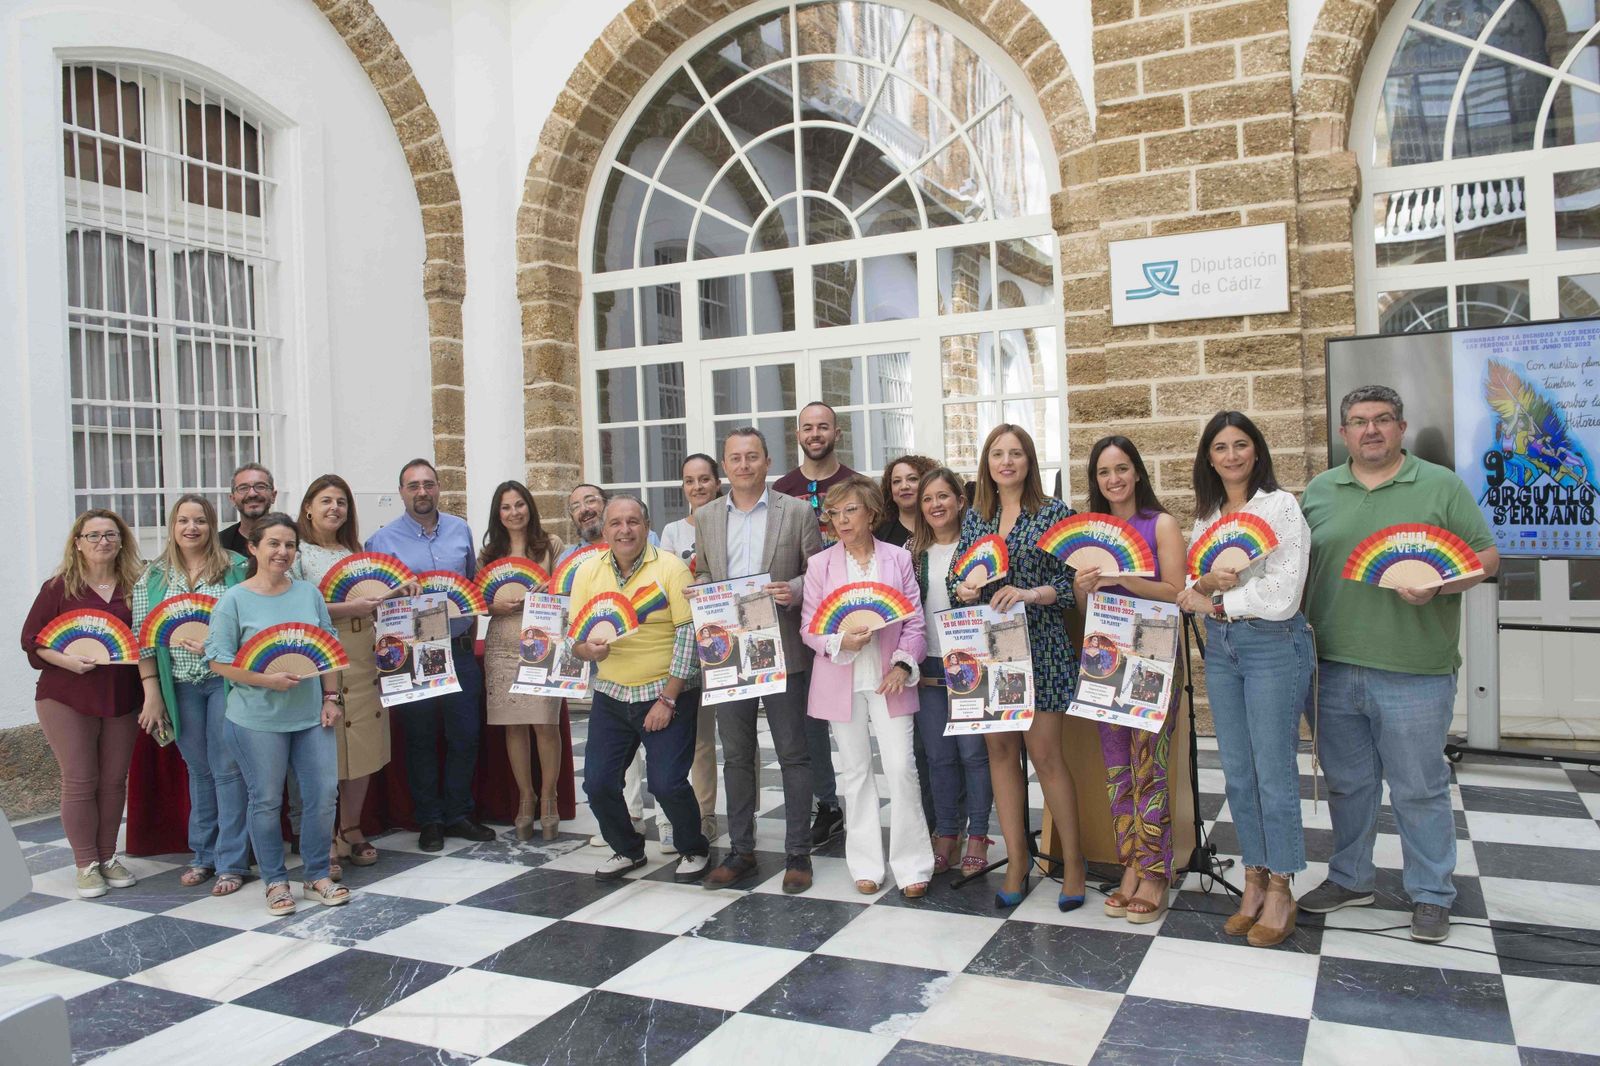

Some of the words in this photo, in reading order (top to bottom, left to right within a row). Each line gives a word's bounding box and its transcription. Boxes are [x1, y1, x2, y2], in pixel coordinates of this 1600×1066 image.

[1191, 252, 1277, 274] Diputación
[1192, 280, 1210, 295] de
[1217, 274, 1262, 292] Cádiz
[1526, 360, 1546, 371] Con
[1488, 482, 1595, 507] ORGULLO
[1493, 505, 1595, 525] SERRANO
